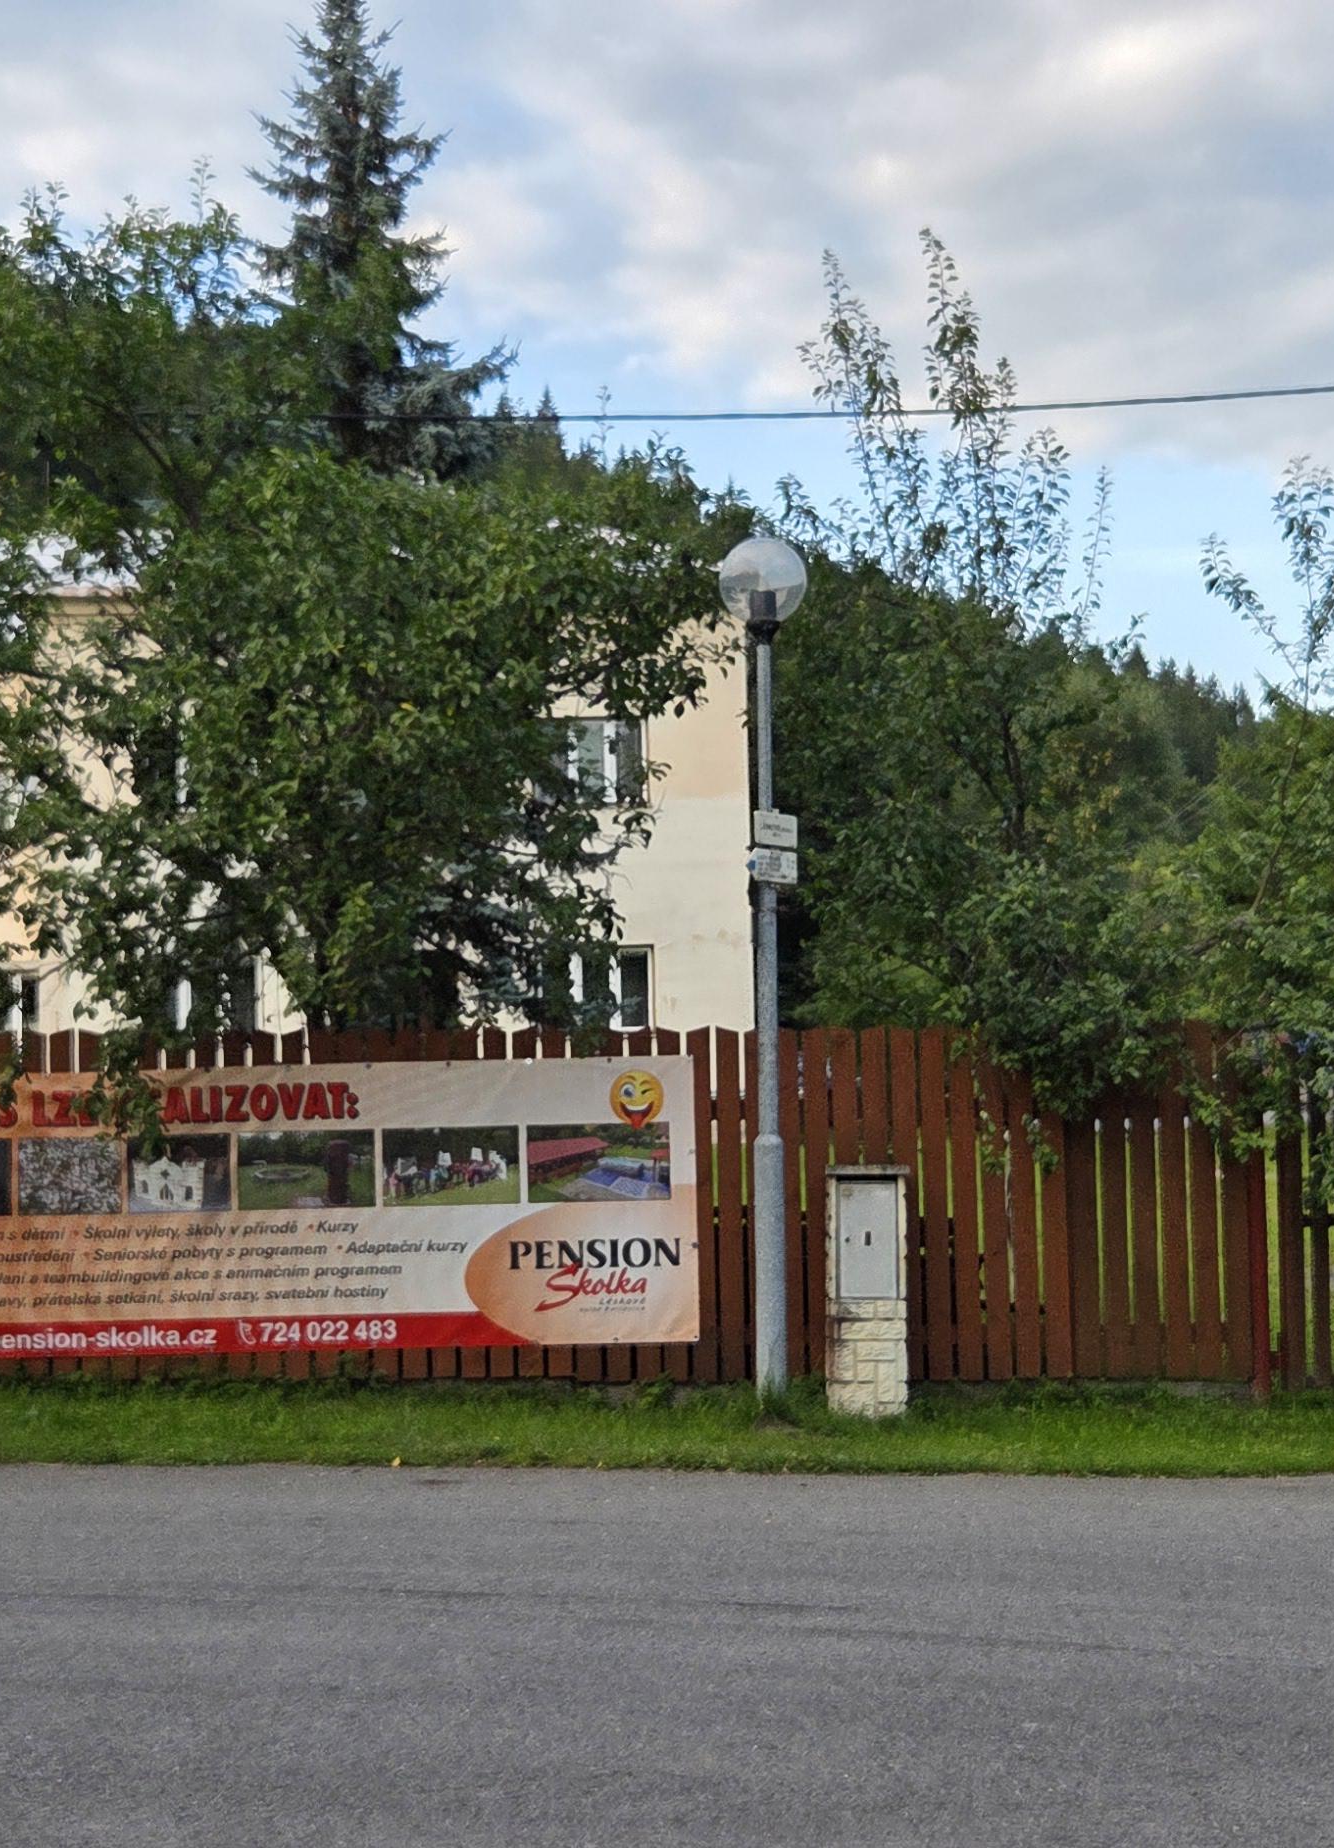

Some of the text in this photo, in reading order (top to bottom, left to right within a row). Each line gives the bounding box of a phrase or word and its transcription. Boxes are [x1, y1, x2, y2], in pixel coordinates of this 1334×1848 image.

[159, 1081, 360, 1124] ALIZOVAT:
[9, 1231, 18, 1241] s
[82, 1223, 132, 1241] Školní
[185, 1222, 227, 1240] školy
[229, 1225, 238, 1235] v
[242, 1220, 299, 1238] přírodě
[316, 1219, 360, 1236] Kurzy
[171, 1245, 223, 1262] pobyty
[227, 1247, 237, 1258] s
[238, 1243, 328, 1261] programem
[344, 1239, 469, 1257] Adaptační kurzy
[509, 1237, 682, 1270] PENSION
[173, 1267, 210, 1281] akce
[213, 1269, 223, 1281] s
[225, 1264, 310, 1280] animačním
[314, 1264, 403, 1281] programem
[169, 1289, 216, 1304] školní
[266, 1285, 330, 1301] svatební
[333, 1284, 390, 1301] hostiny
[259, 1321, 302, 1343] 724
[307, 1320, 350, 1342] 022
[354, 1318, 398, 1341] 483
